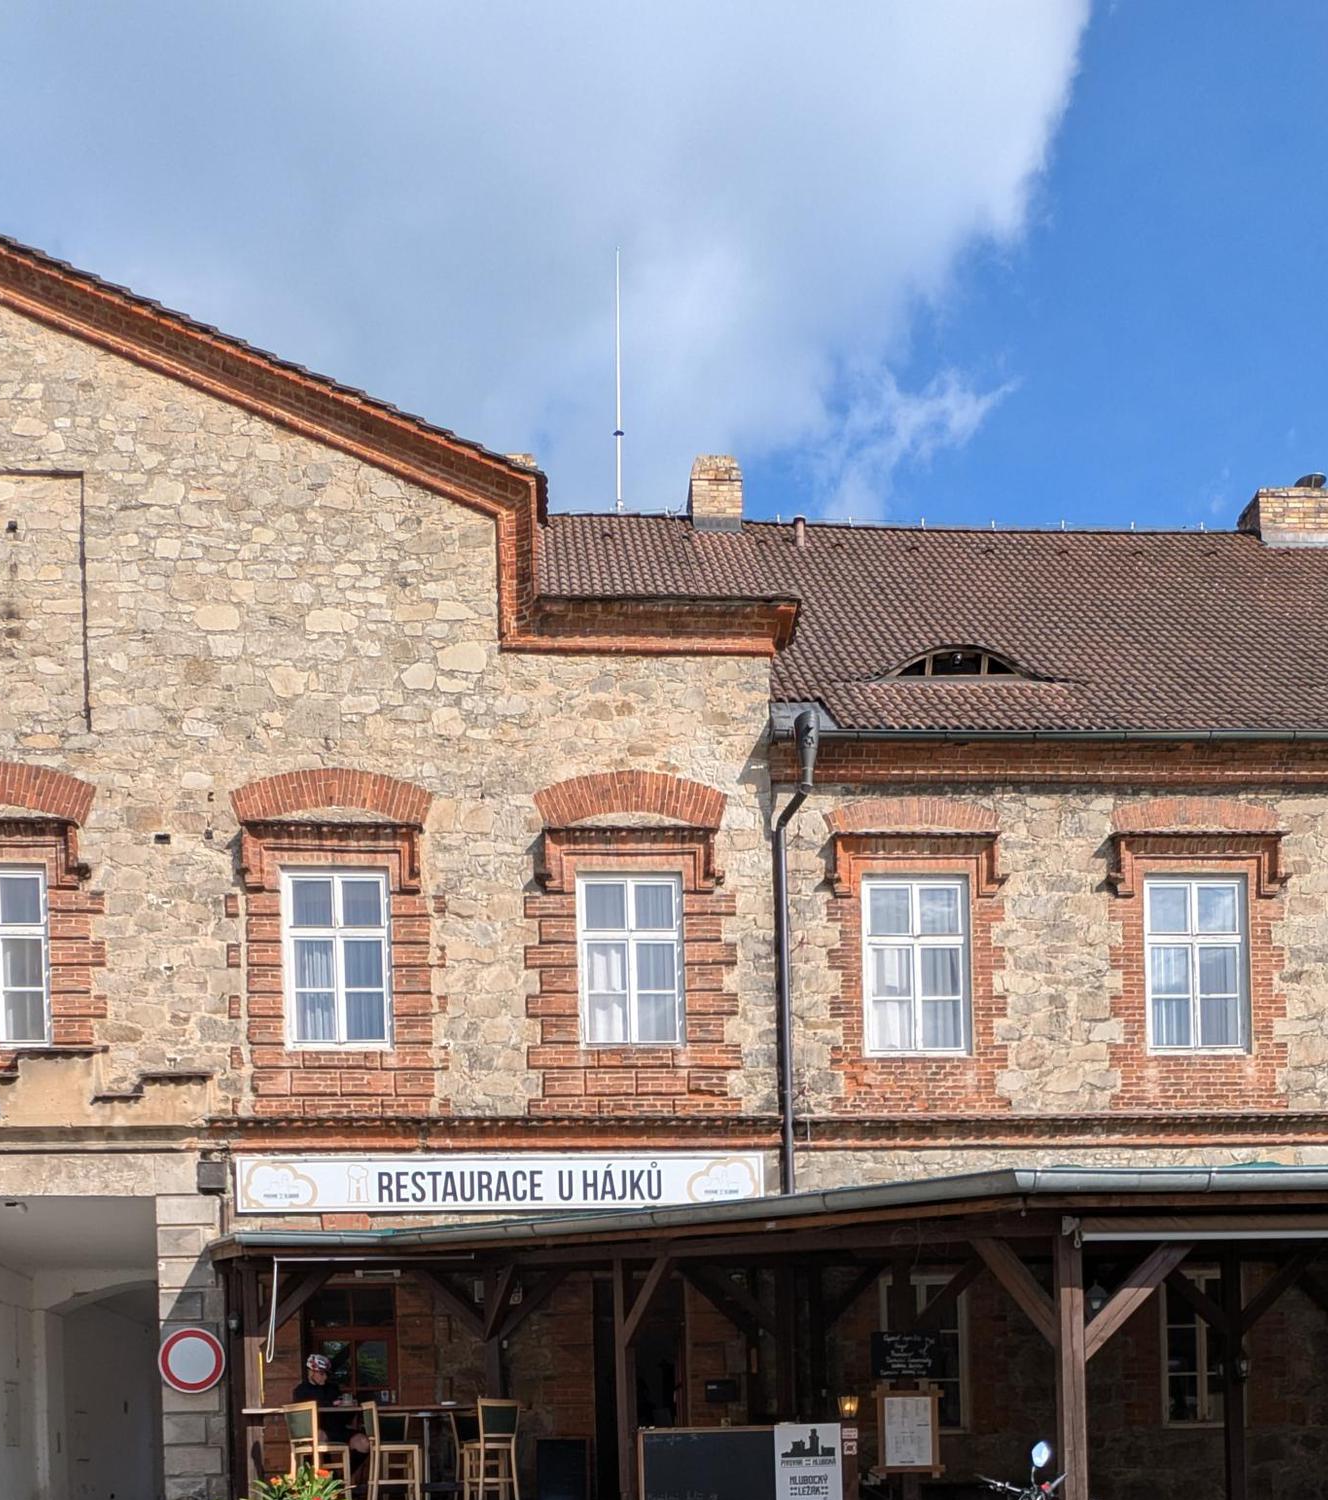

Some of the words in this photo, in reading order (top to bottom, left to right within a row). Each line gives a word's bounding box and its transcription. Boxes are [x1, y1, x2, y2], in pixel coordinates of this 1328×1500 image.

[377, 1170, 544, 1203] RESTAURACE
[558, 1170, 573, 1202] U
[582, 1161, 662, 1201] HÁJKŮ
